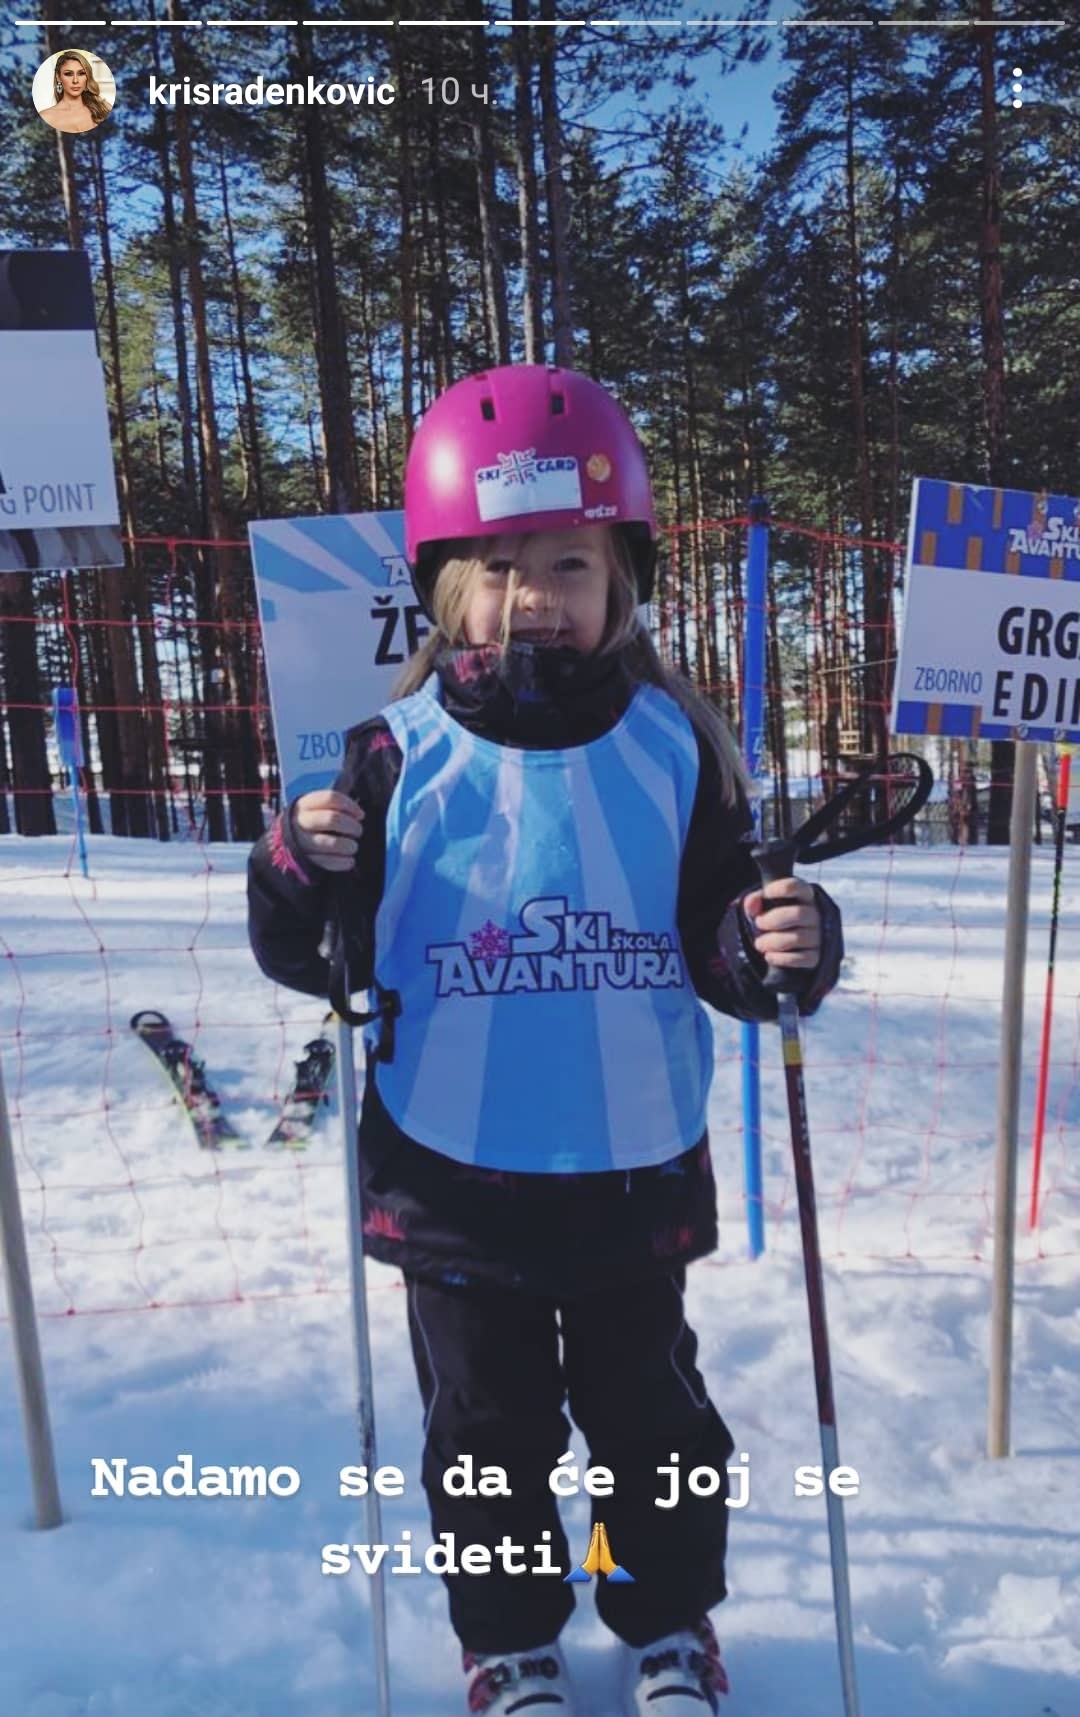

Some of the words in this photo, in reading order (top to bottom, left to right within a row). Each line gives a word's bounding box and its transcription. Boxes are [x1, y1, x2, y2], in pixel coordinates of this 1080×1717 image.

[536, 459, 577, 473] CARD
[23, 483, 97, 515] POINT
[1042, 516, 1080, 541] SKI
[998, 606, 1080, 660] GRG
[914, 667, 983, 694] ZBORNO
[295, 731, 345, 761] ZBO
[509, 896, 612, 954] SKI
[426, 942, 685, 997] AVANTURA
